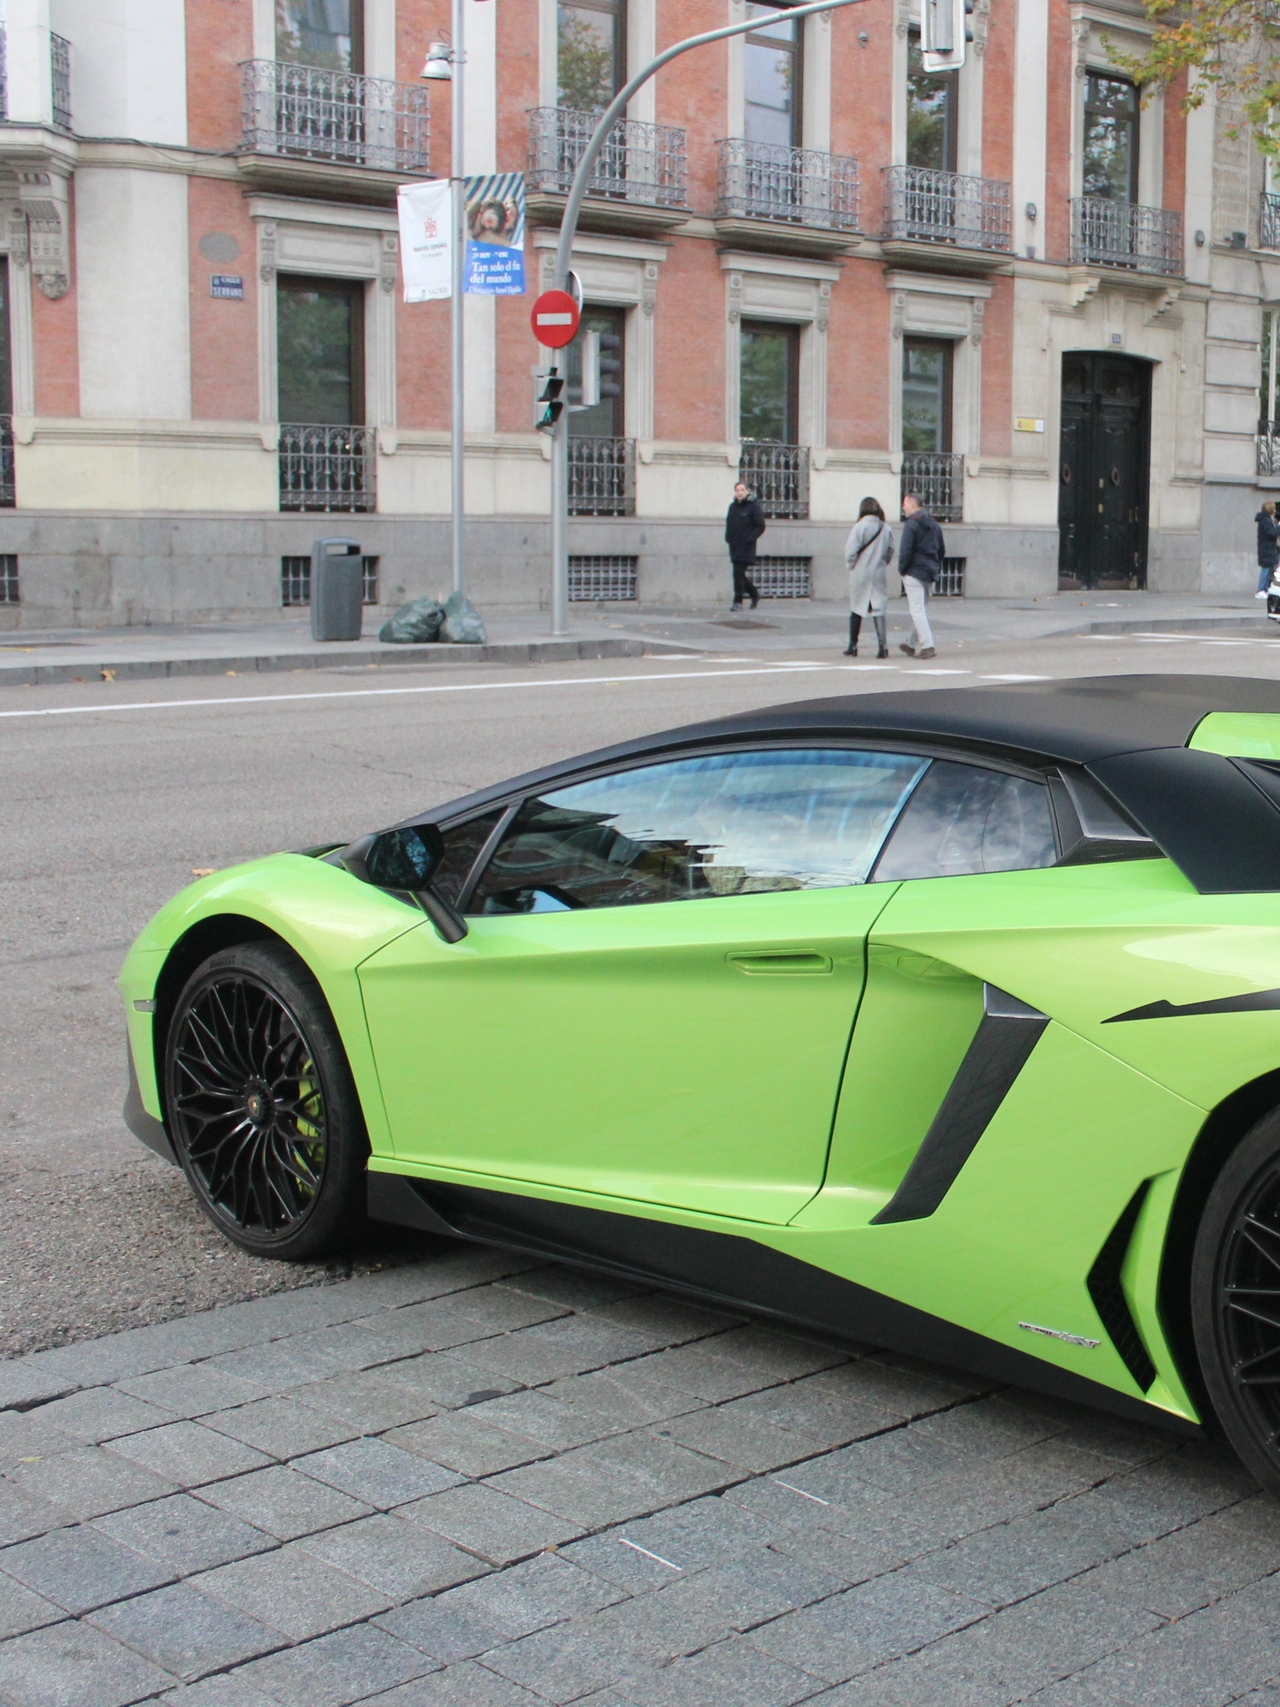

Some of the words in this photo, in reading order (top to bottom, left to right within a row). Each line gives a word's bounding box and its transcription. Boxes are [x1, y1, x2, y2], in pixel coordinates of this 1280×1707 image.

[472, 262, 488, 272] Tan
[490, 261, 505, 271] solo
[513, 260, 521, 271] fin
[470, 273, 484, 283] del
[486, 273, 512, 283] mundo
[212, 287, 242, 297] SERRANO
